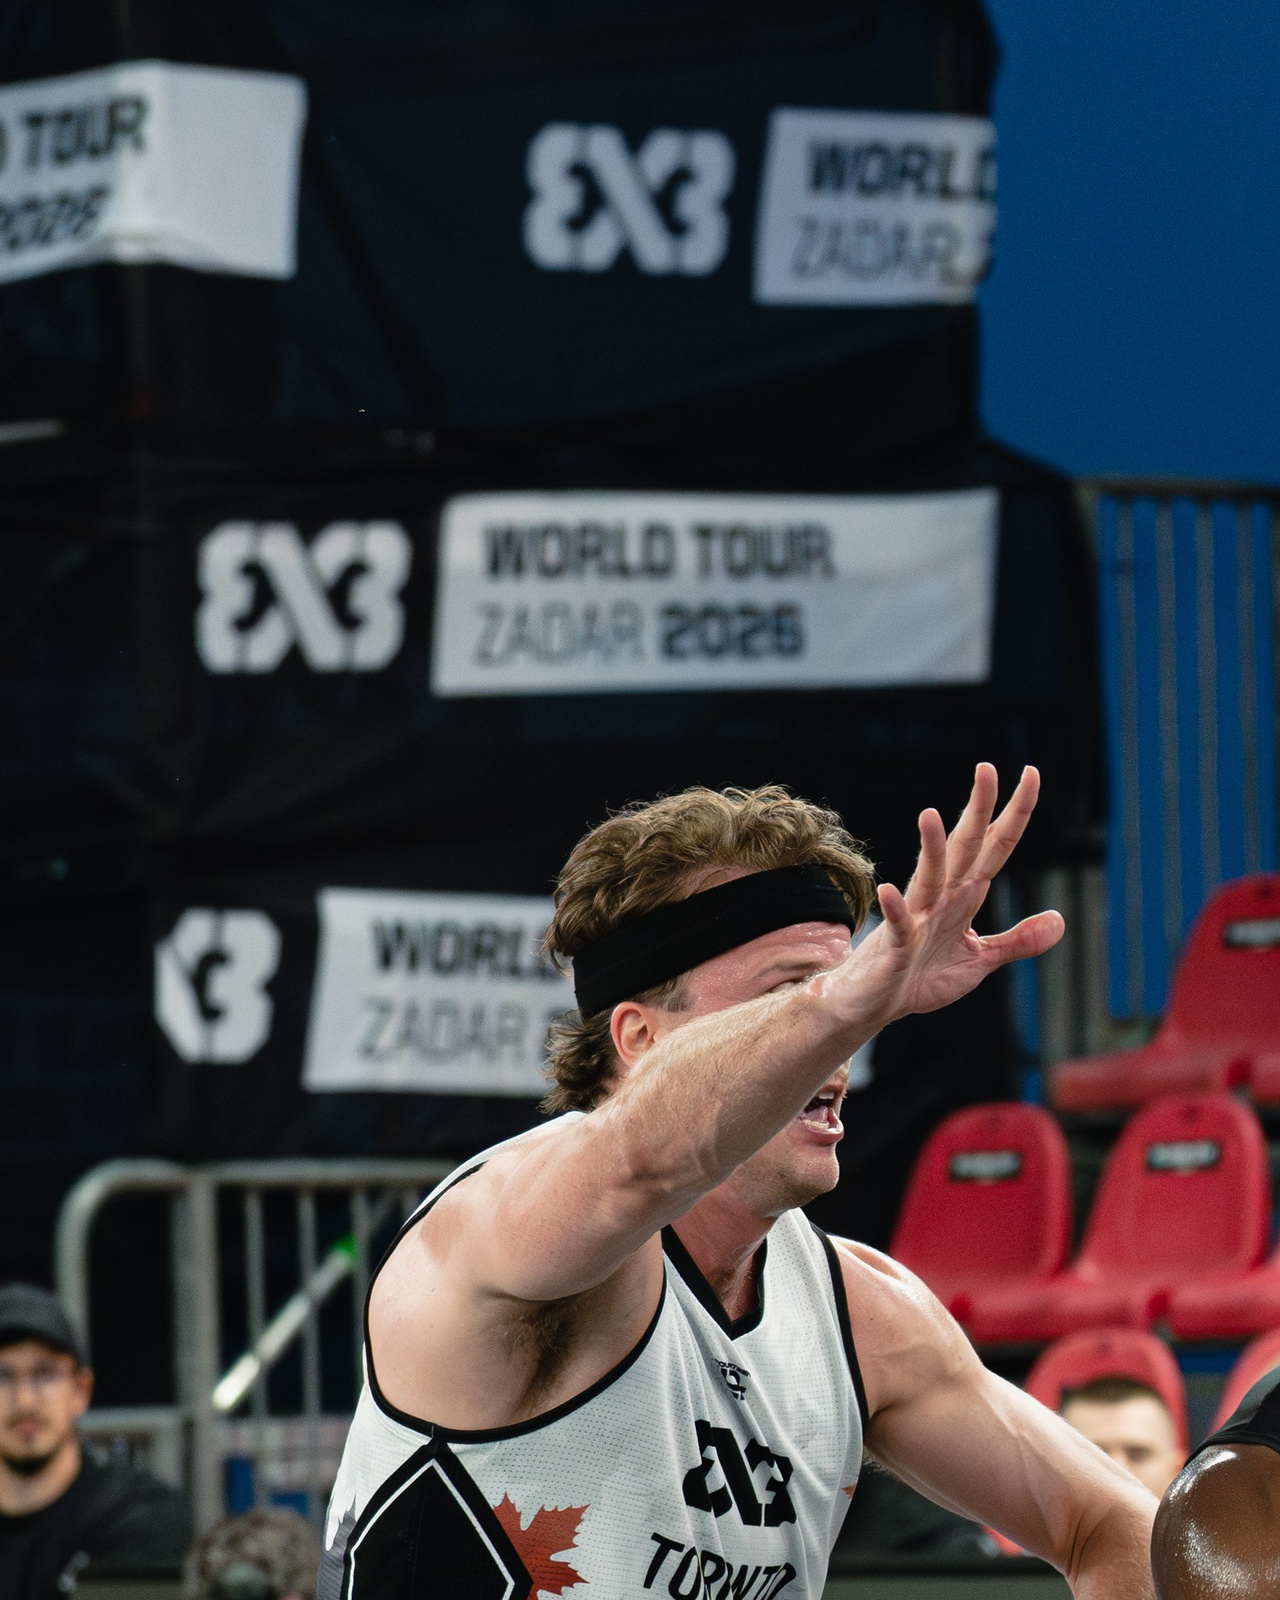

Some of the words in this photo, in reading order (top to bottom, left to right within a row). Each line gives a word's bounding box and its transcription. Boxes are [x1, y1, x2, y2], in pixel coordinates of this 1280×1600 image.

[484, 521, 675, 583] WORLD
[694, 521, 838, 583] TOUR
[472, 602, 648, 666] ZADAR
[658, 604, 811, 661] 2026
